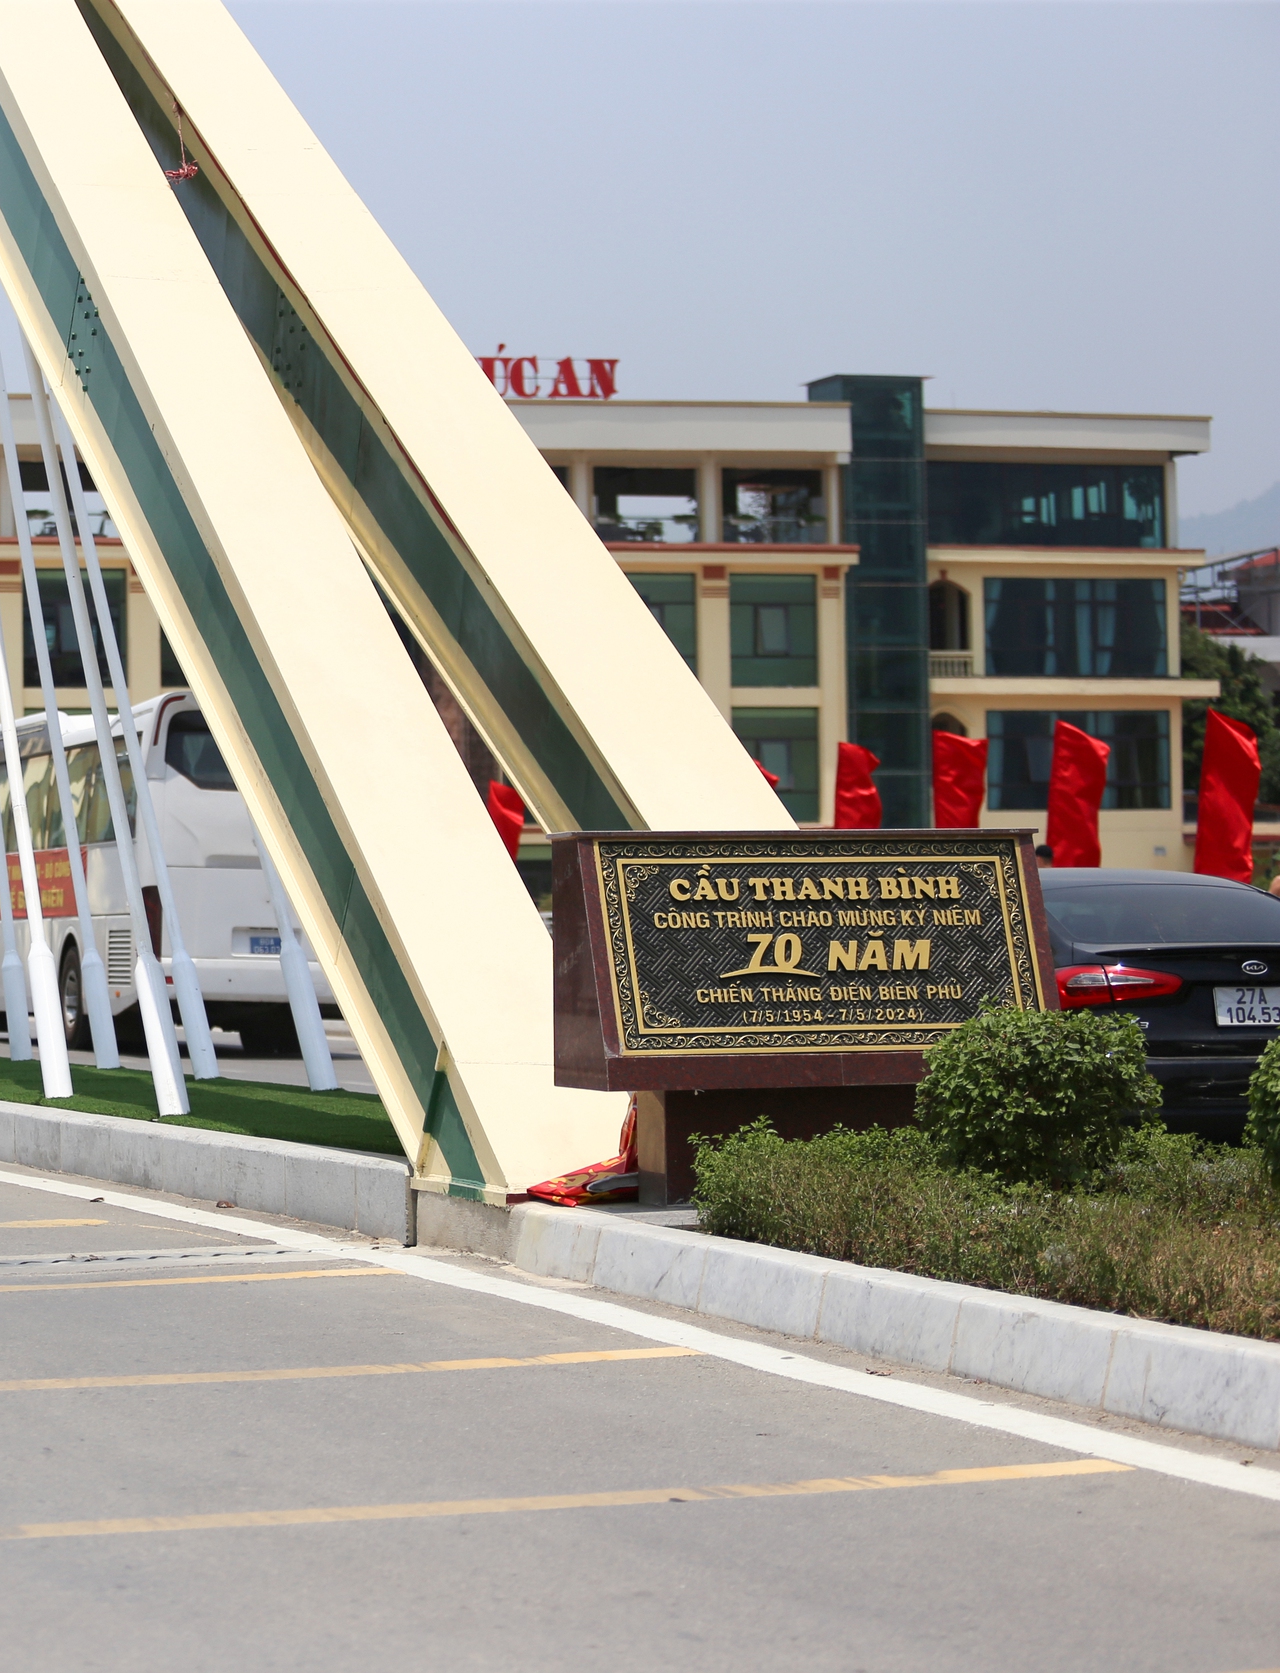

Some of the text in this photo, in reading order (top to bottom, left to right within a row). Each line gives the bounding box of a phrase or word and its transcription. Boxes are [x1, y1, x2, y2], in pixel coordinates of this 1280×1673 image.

[548, 356, 620, 400] AN
[669, 864, 961, 901] CẦU THANH BÌNH
[653, 903, 982, 930] CÔNG TRÌNH CHÀO MỪNG KỶ NIỆM
[747, 930, 931, 971] 70 NĂM
[696, 977, 962, 1004] CHIẾN THẮNG ĐIỆN BIÊN PHỦ
[1235, 988, 1268, 1005] 27A
[743, 1009, 823, 1024] (7/5/1954
[839, 1008, 924, 1022] 7/5/2024)
[1226, 1006, 1280, 1024] 104.53
